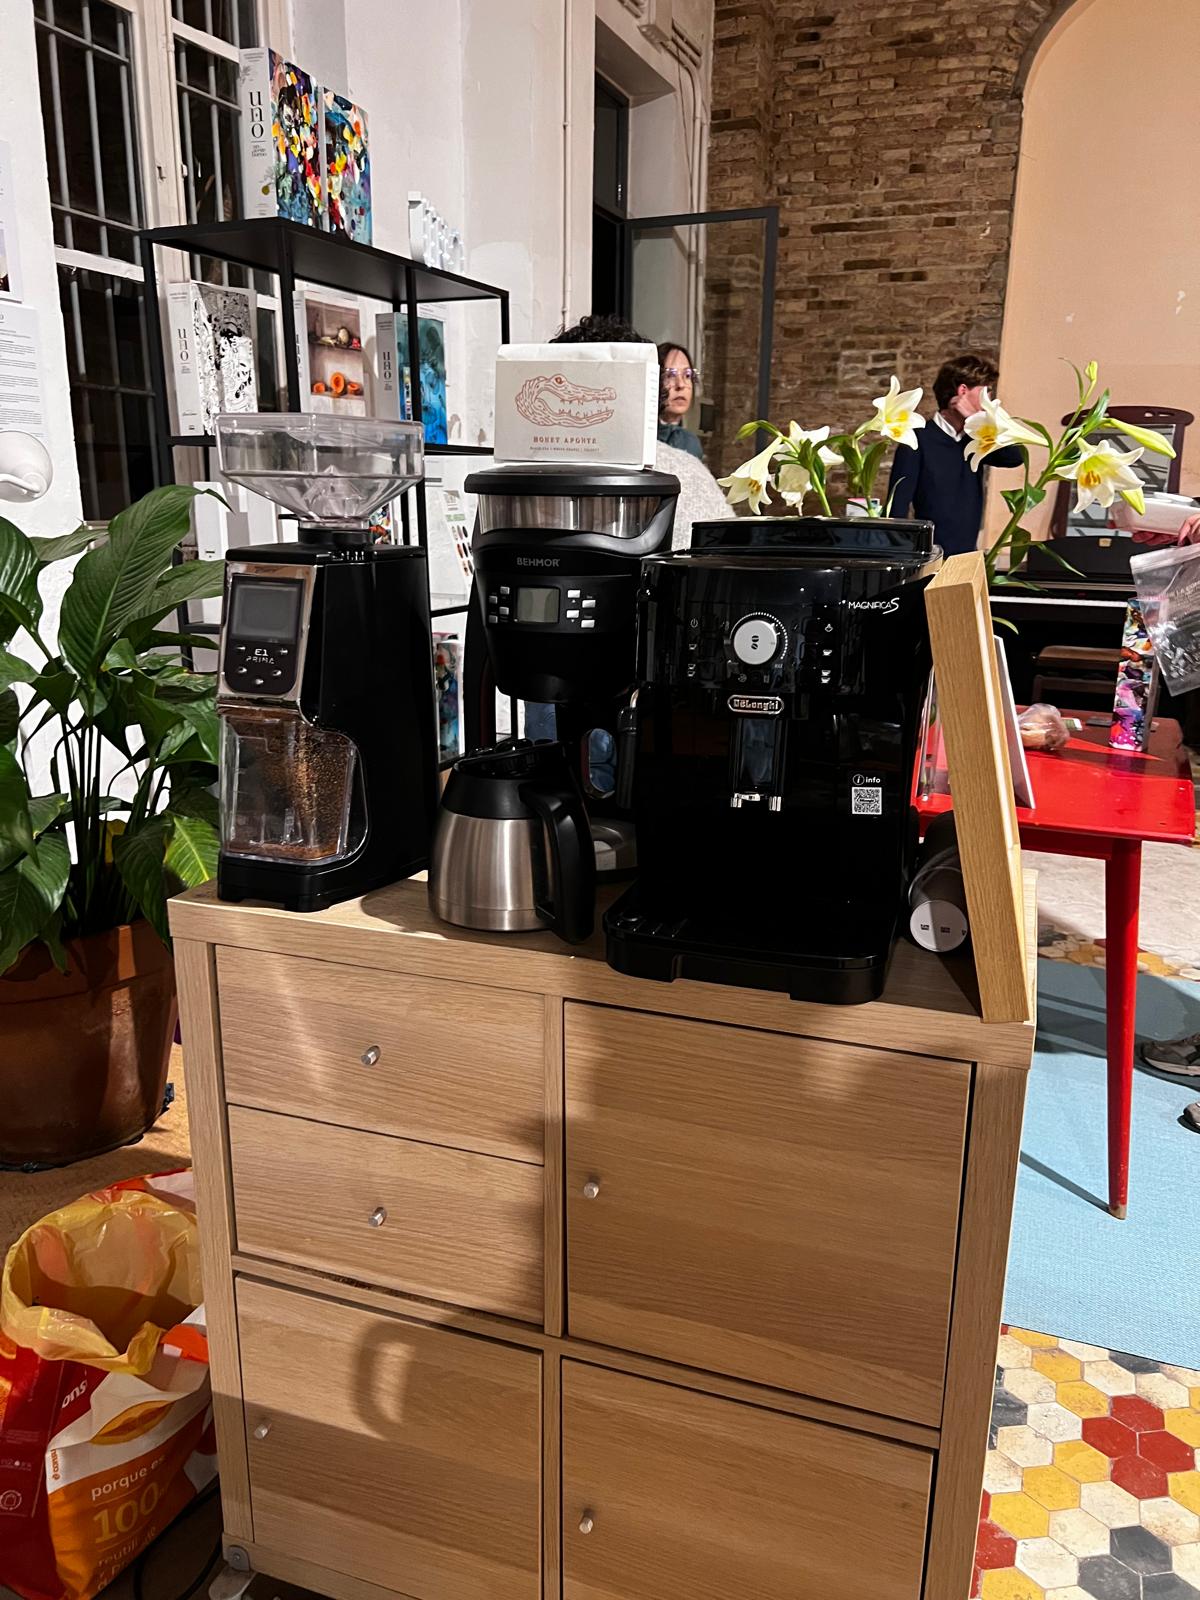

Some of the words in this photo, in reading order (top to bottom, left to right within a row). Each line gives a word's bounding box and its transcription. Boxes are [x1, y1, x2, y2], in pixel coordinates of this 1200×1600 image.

[249, 91, 265, 139] uno
[516, 557, 560, 567] BEHMOR
[254, 648, 269, 657] E1
[865, 776, 881, 784] info
[91, 1466, 148, 1501] porque
